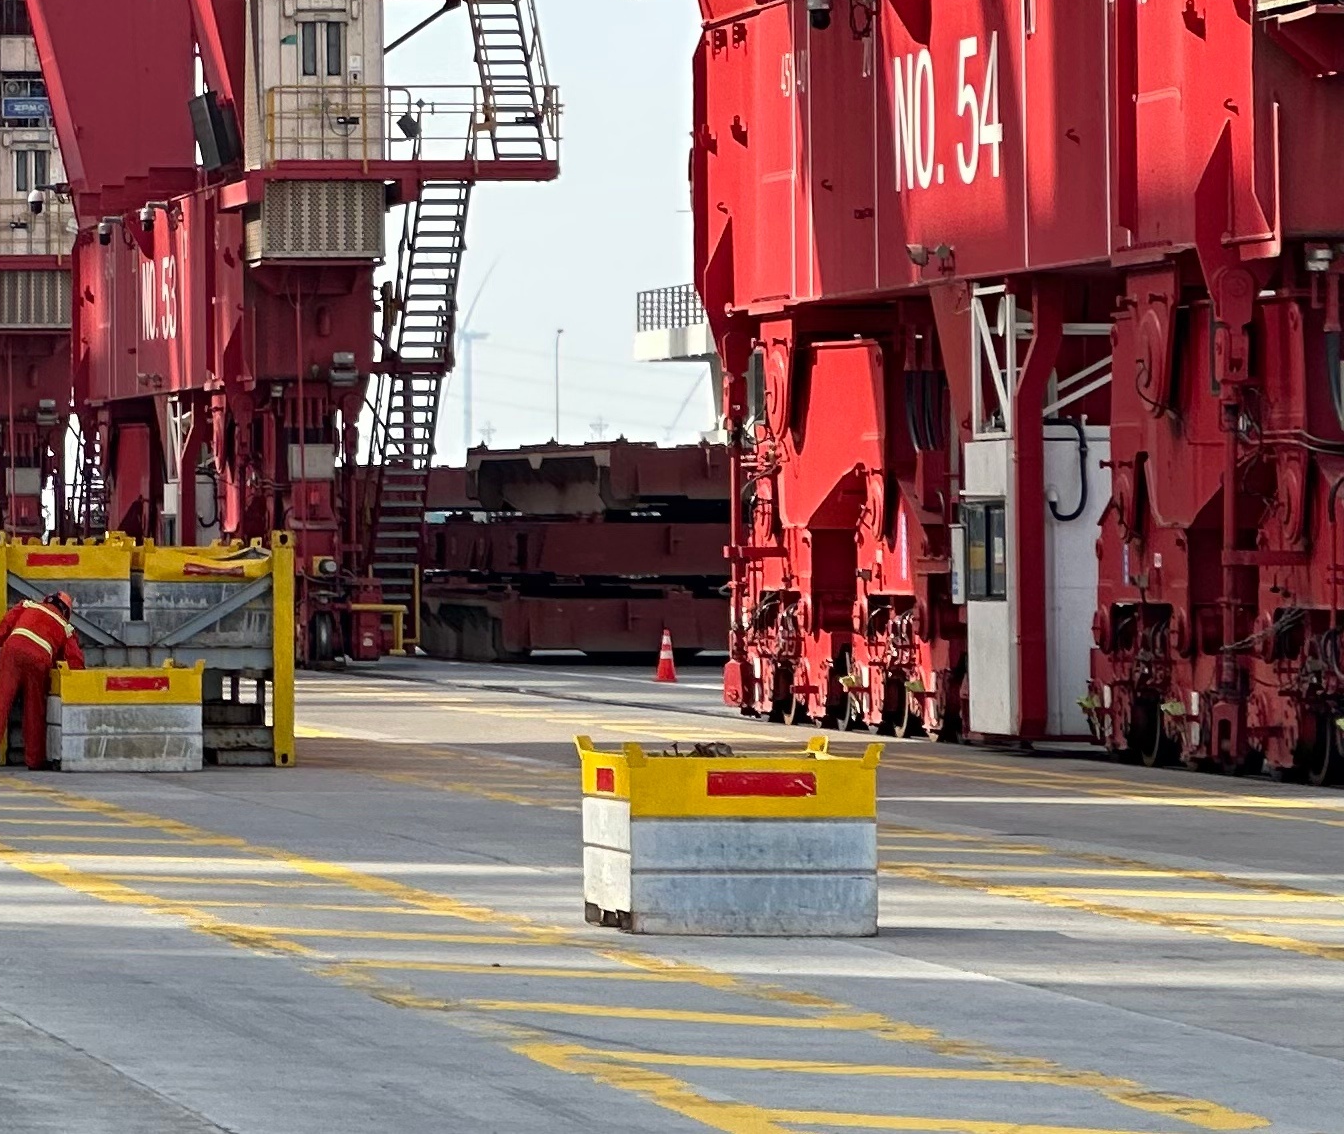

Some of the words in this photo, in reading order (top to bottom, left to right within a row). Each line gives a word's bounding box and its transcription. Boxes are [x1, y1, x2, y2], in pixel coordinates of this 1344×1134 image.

[895, 49, 944, 191] NO.
[957, 31, 1002, 184] 54
[162, 255, 176, 339] 53
